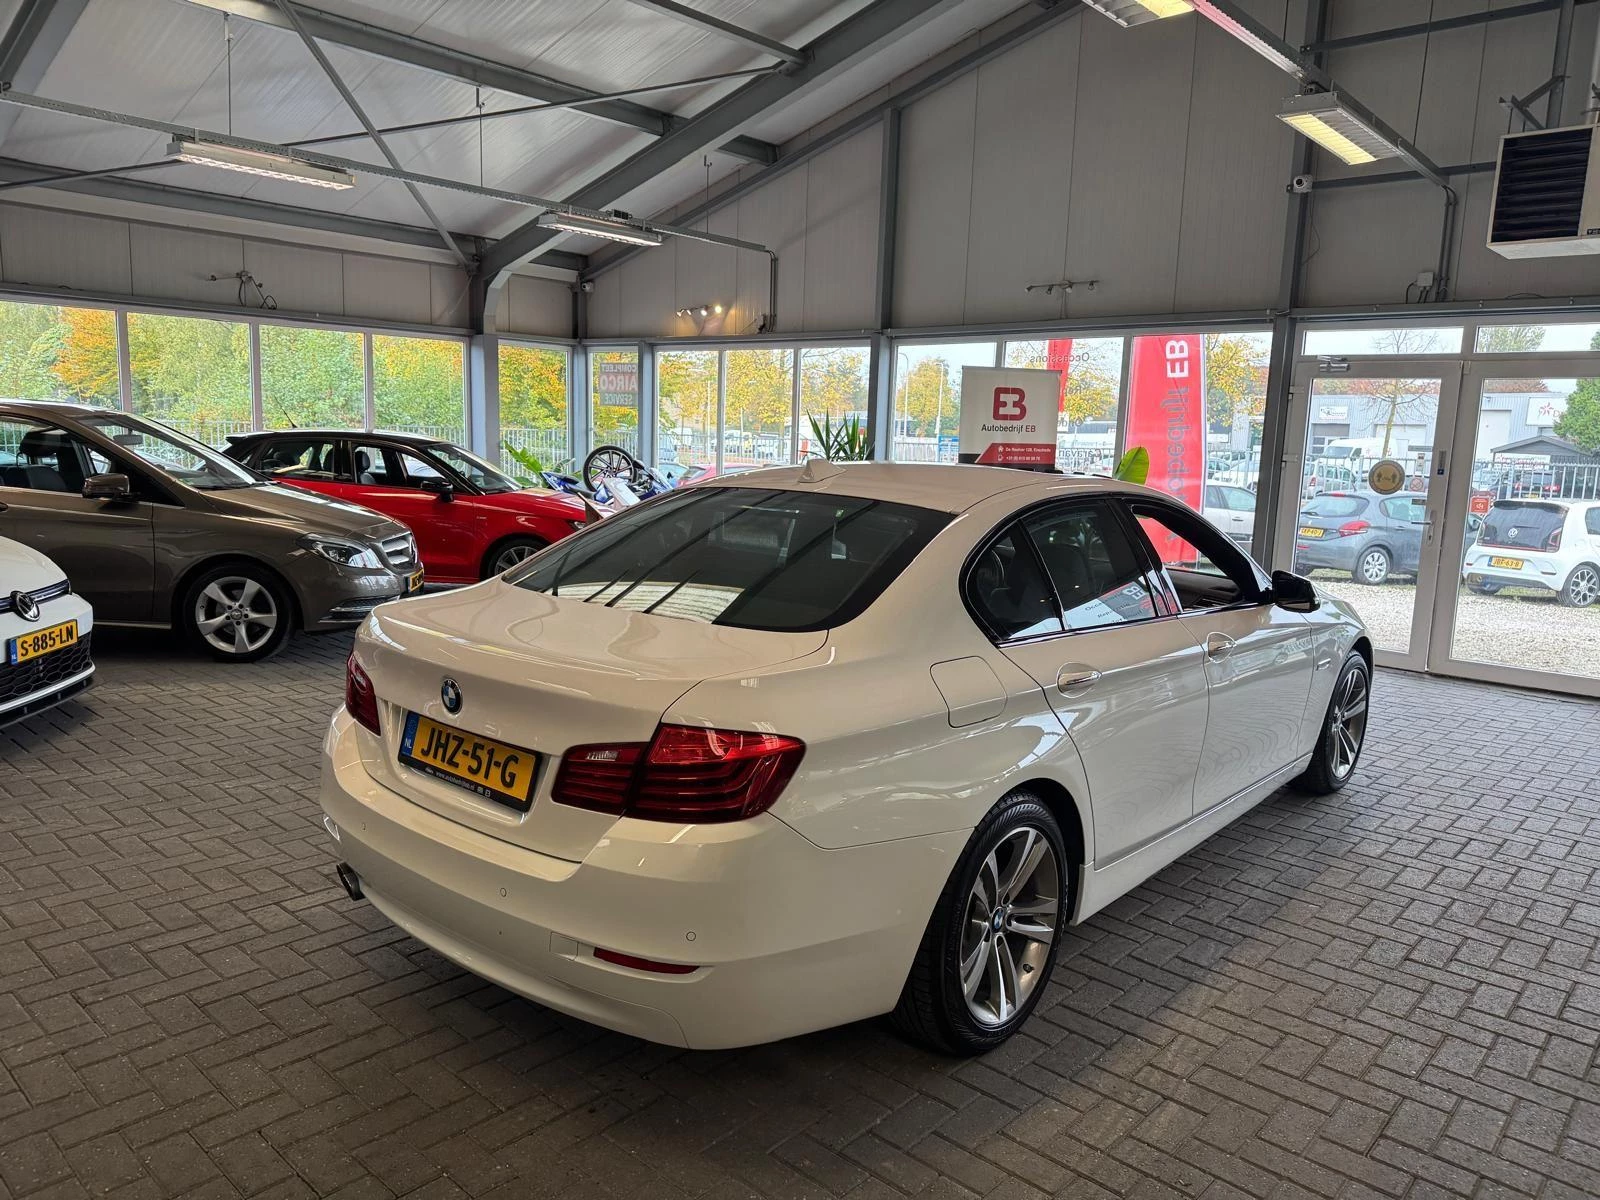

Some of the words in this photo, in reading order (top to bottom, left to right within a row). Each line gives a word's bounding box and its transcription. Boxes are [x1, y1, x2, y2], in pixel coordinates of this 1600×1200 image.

[992, 386, 1027, 421] EB
[981, 423, 1023, 434] Autobedrijf
[1025, 424, 1036, 433] EB
[20, 624, 74, 657] S-885-LN
[404, 738, 412, 749] NL
[420, 726, 520, 789] JHZ-51-G
